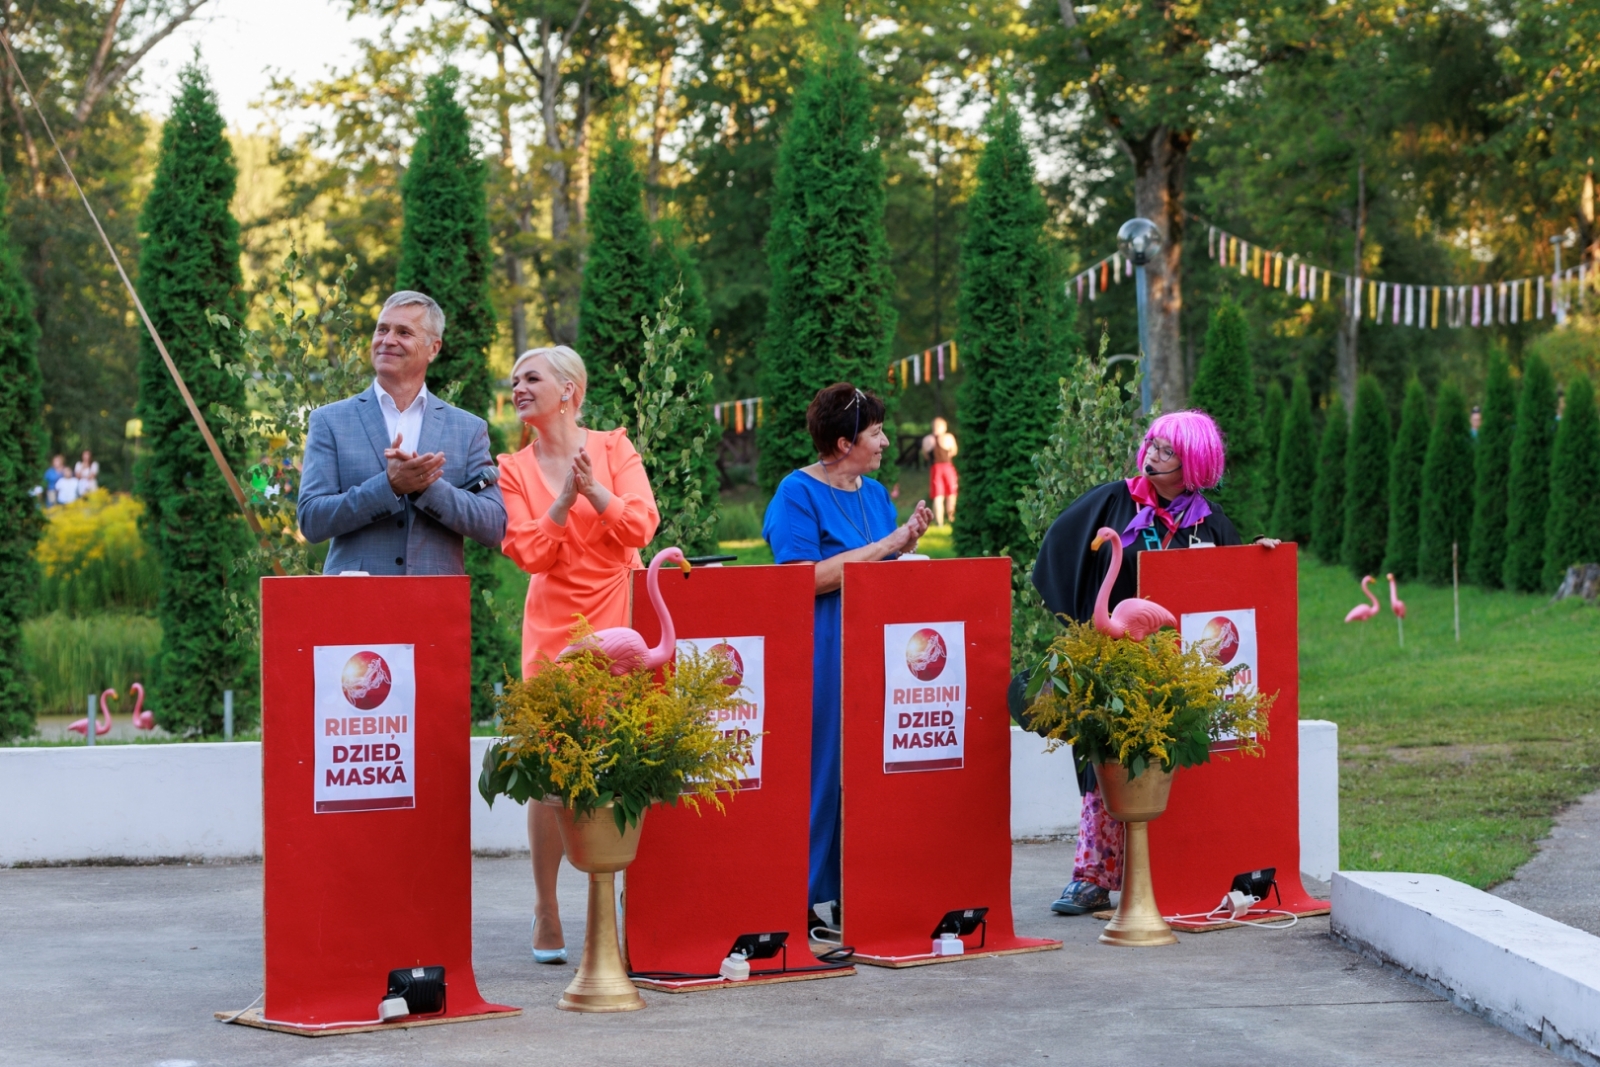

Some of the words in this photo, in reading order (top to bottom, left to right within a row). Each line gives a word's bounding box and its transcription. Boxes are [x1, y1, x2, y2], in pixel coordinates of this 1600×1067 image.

[893, 685, 960, 708] RIEBIŅI
[701, 703, 758, 726] EBIŅI
[898, 710, 954, 729] DZIED
[325, 715, 408, 740] RIEBIŅI
[892, 726, 958, 750] MASKĀ
[332, 743, 401, 763] DZIED
[325, 761, 407, 787] MASKĀ
